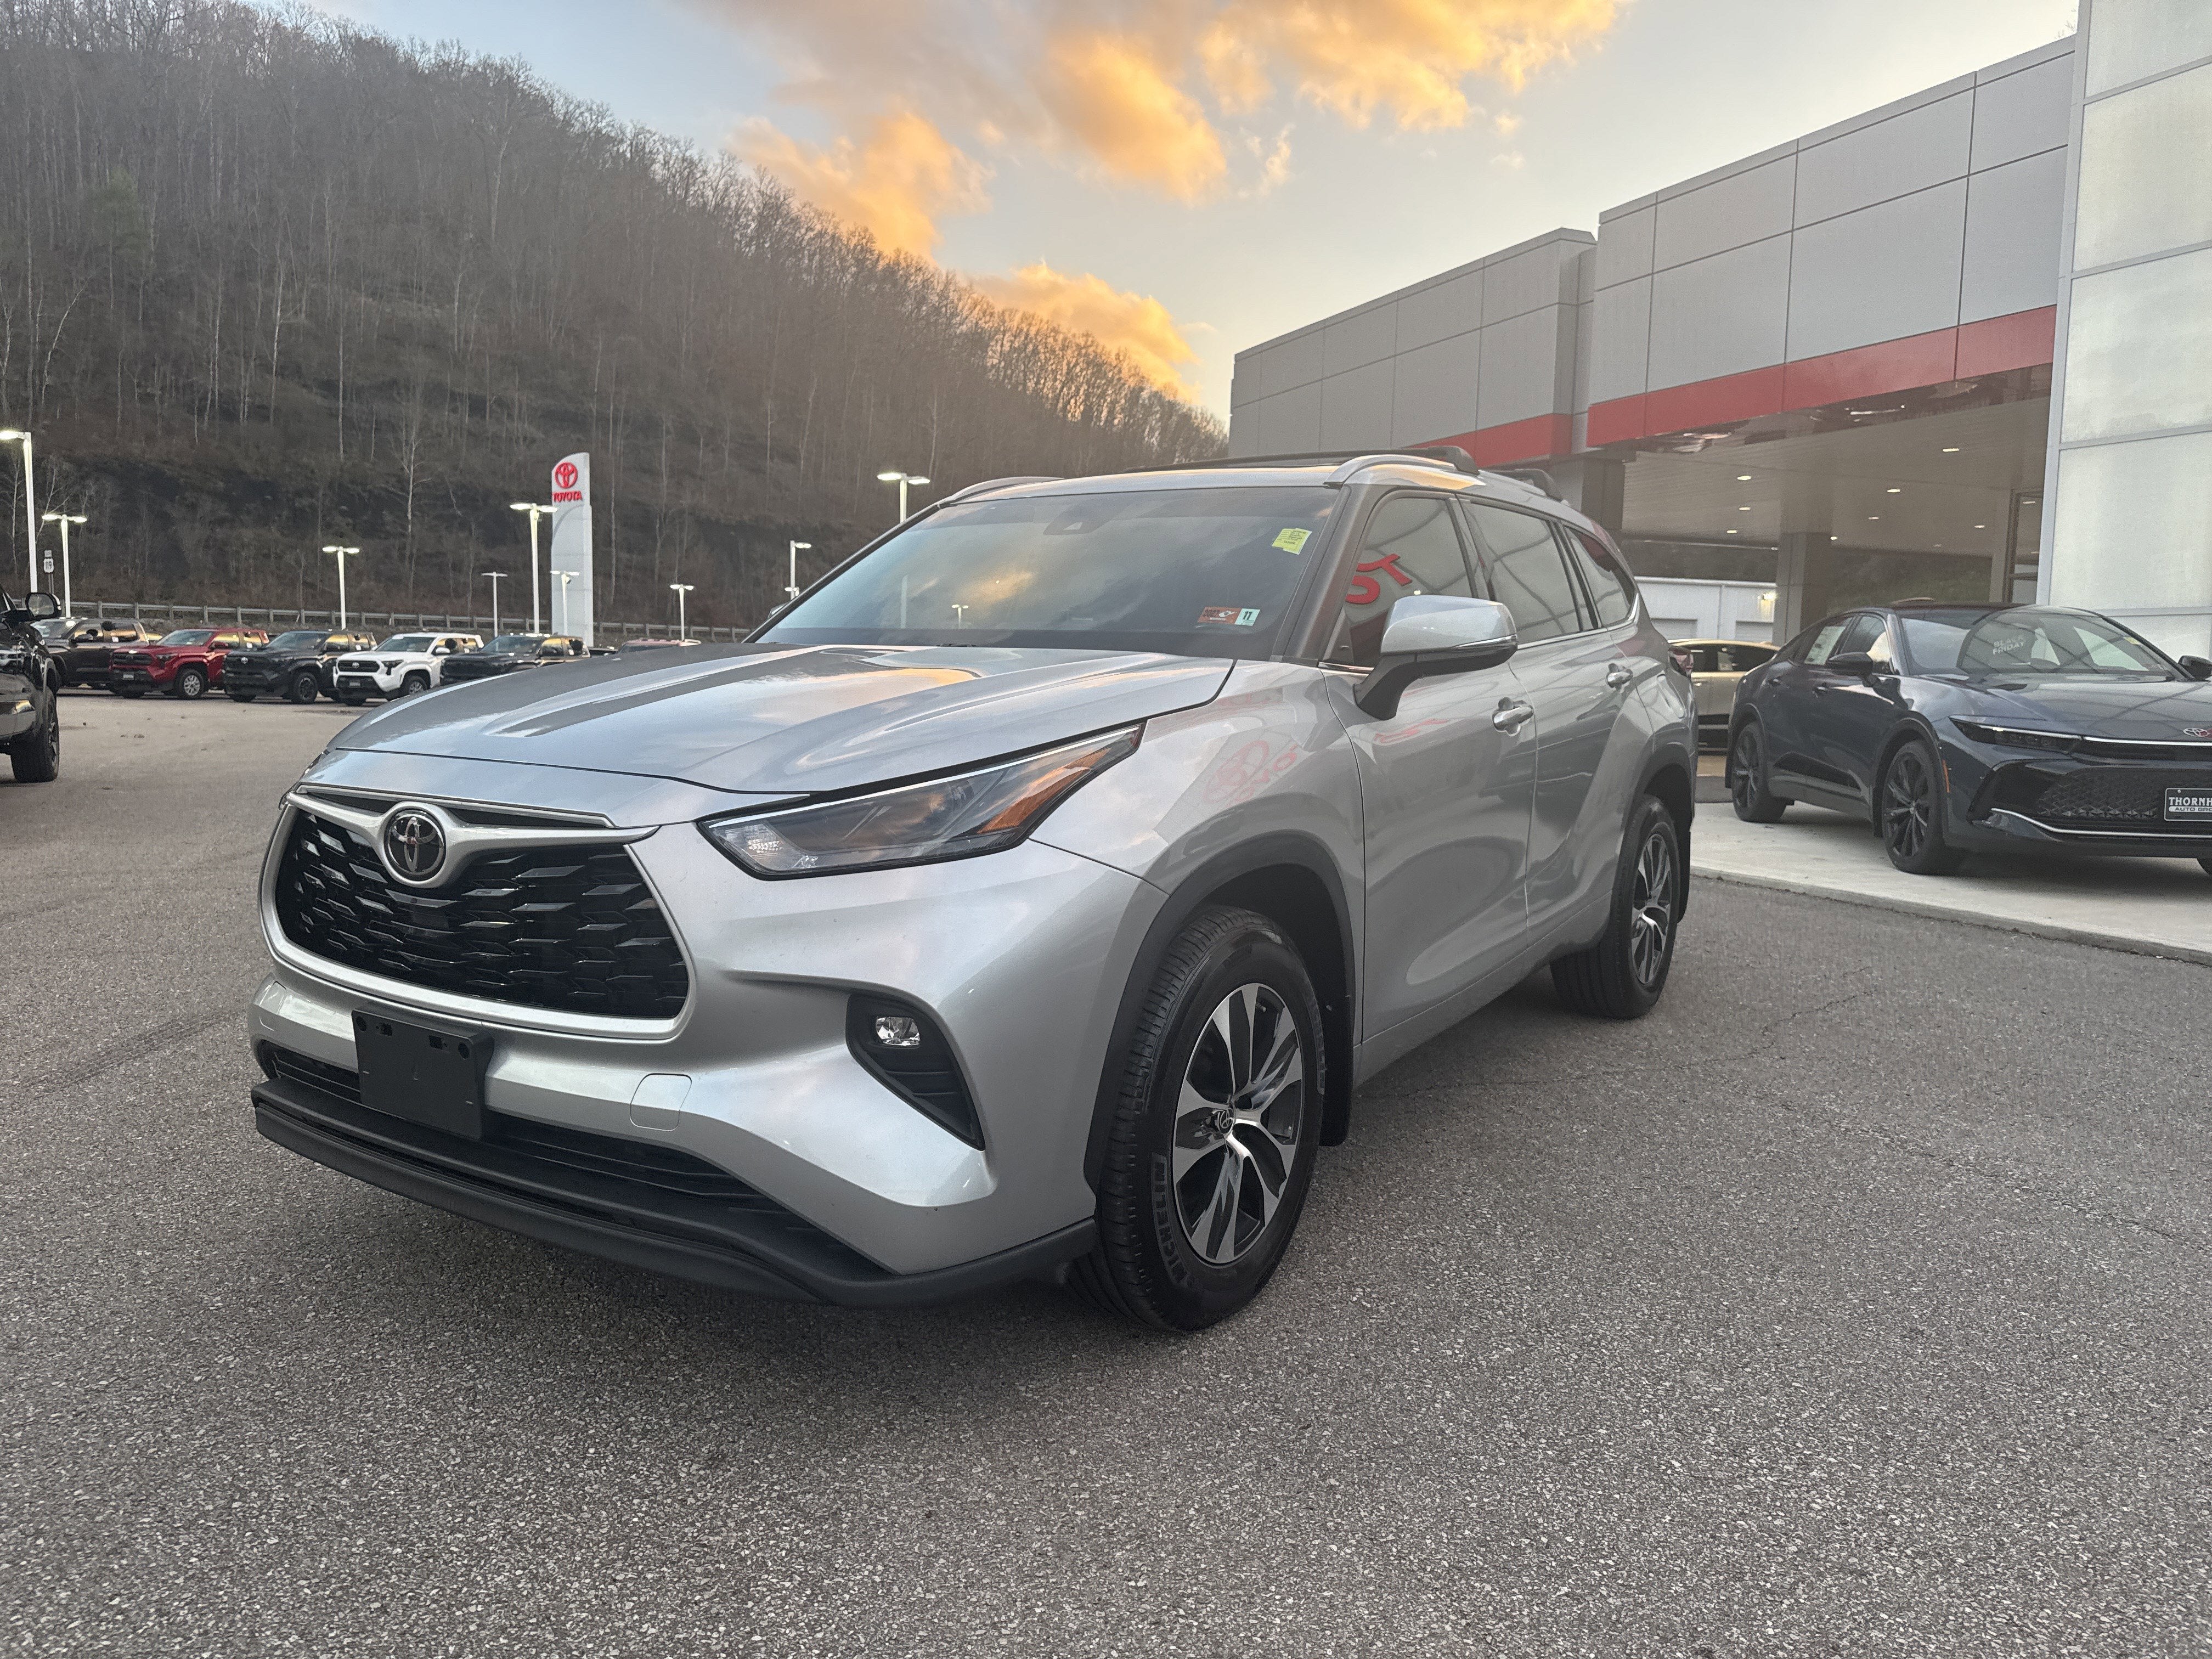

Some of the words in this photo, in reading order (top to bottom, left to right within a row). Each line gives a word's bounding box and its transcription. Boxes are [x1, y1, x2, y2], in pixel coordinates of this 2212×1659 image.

[552, 491, 582, 503] TOYOTA
[1243, 611, 1252, 620] 11
[1993, 641, 2024, 655] FRIDAY
[1154, 1161, 1188, 1283] MICHELIN
